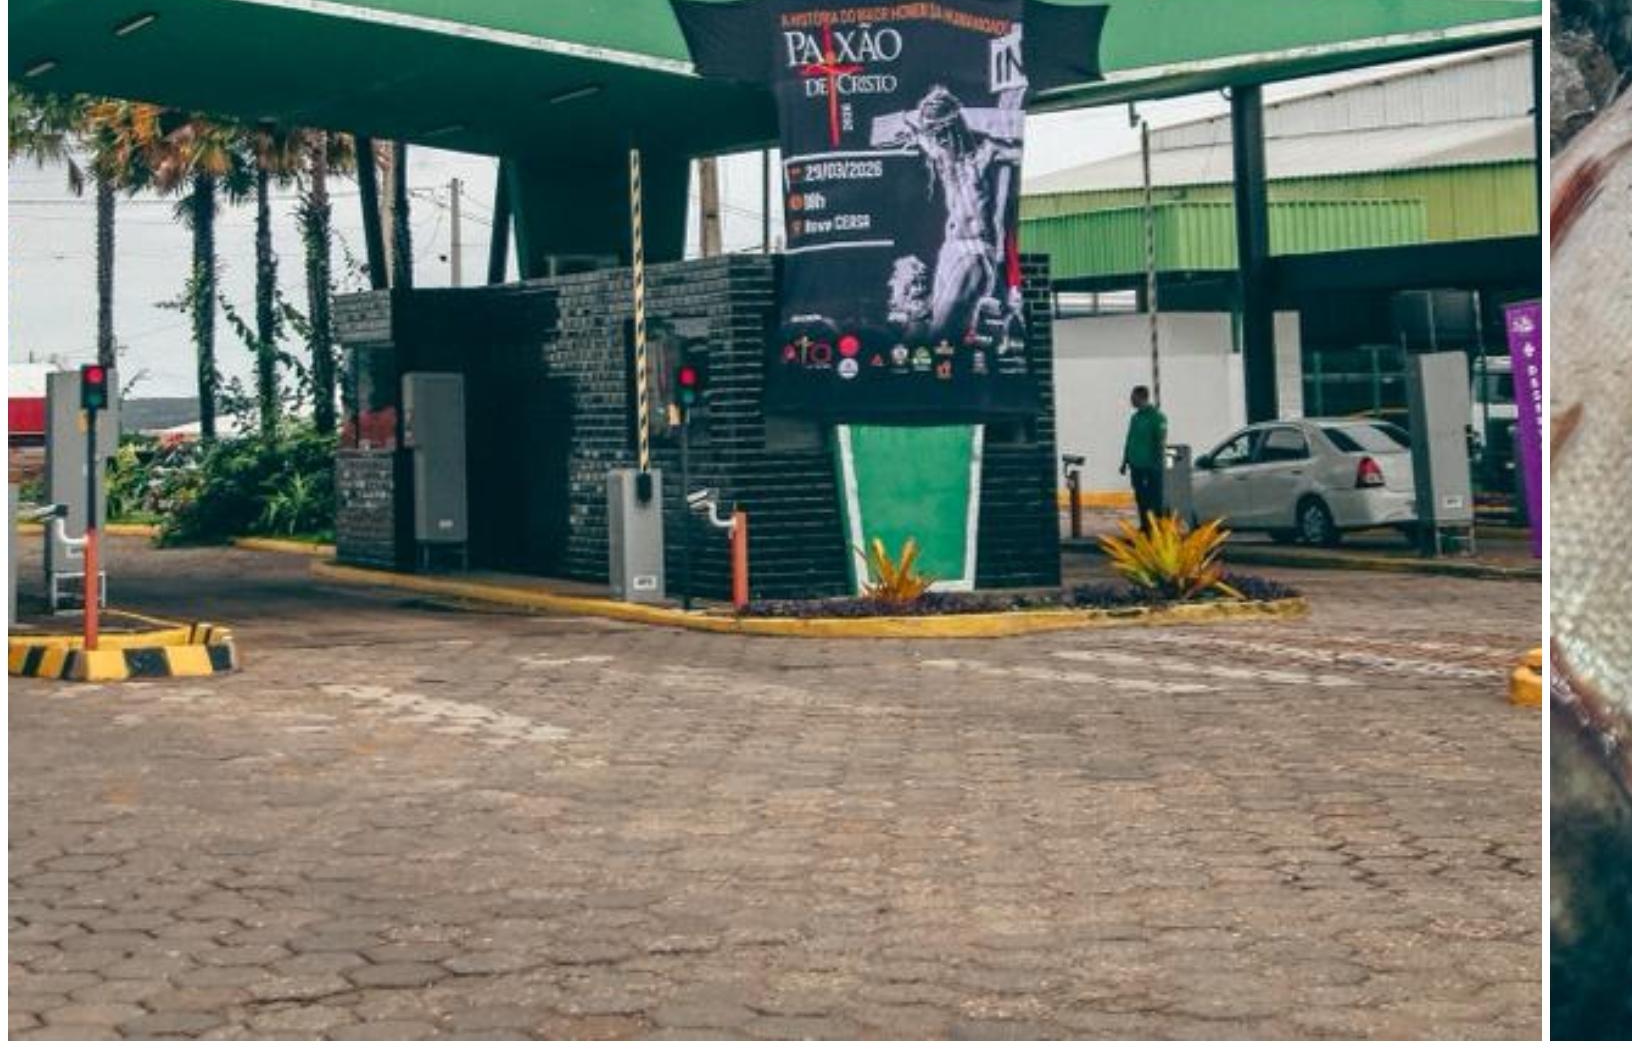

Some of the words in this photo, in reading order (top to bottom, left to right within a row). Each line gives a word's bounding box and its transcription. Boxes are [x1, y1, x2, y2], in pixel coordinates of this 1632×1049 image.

[783, 22, 903, 67] PAIXÃO
[805, 78, 829, 98] DE
[837, 73, 898, 94] CRISTO
[805, 159, 883, 182] 29/03/2026
[834, 213, 871, 231] CEASA
